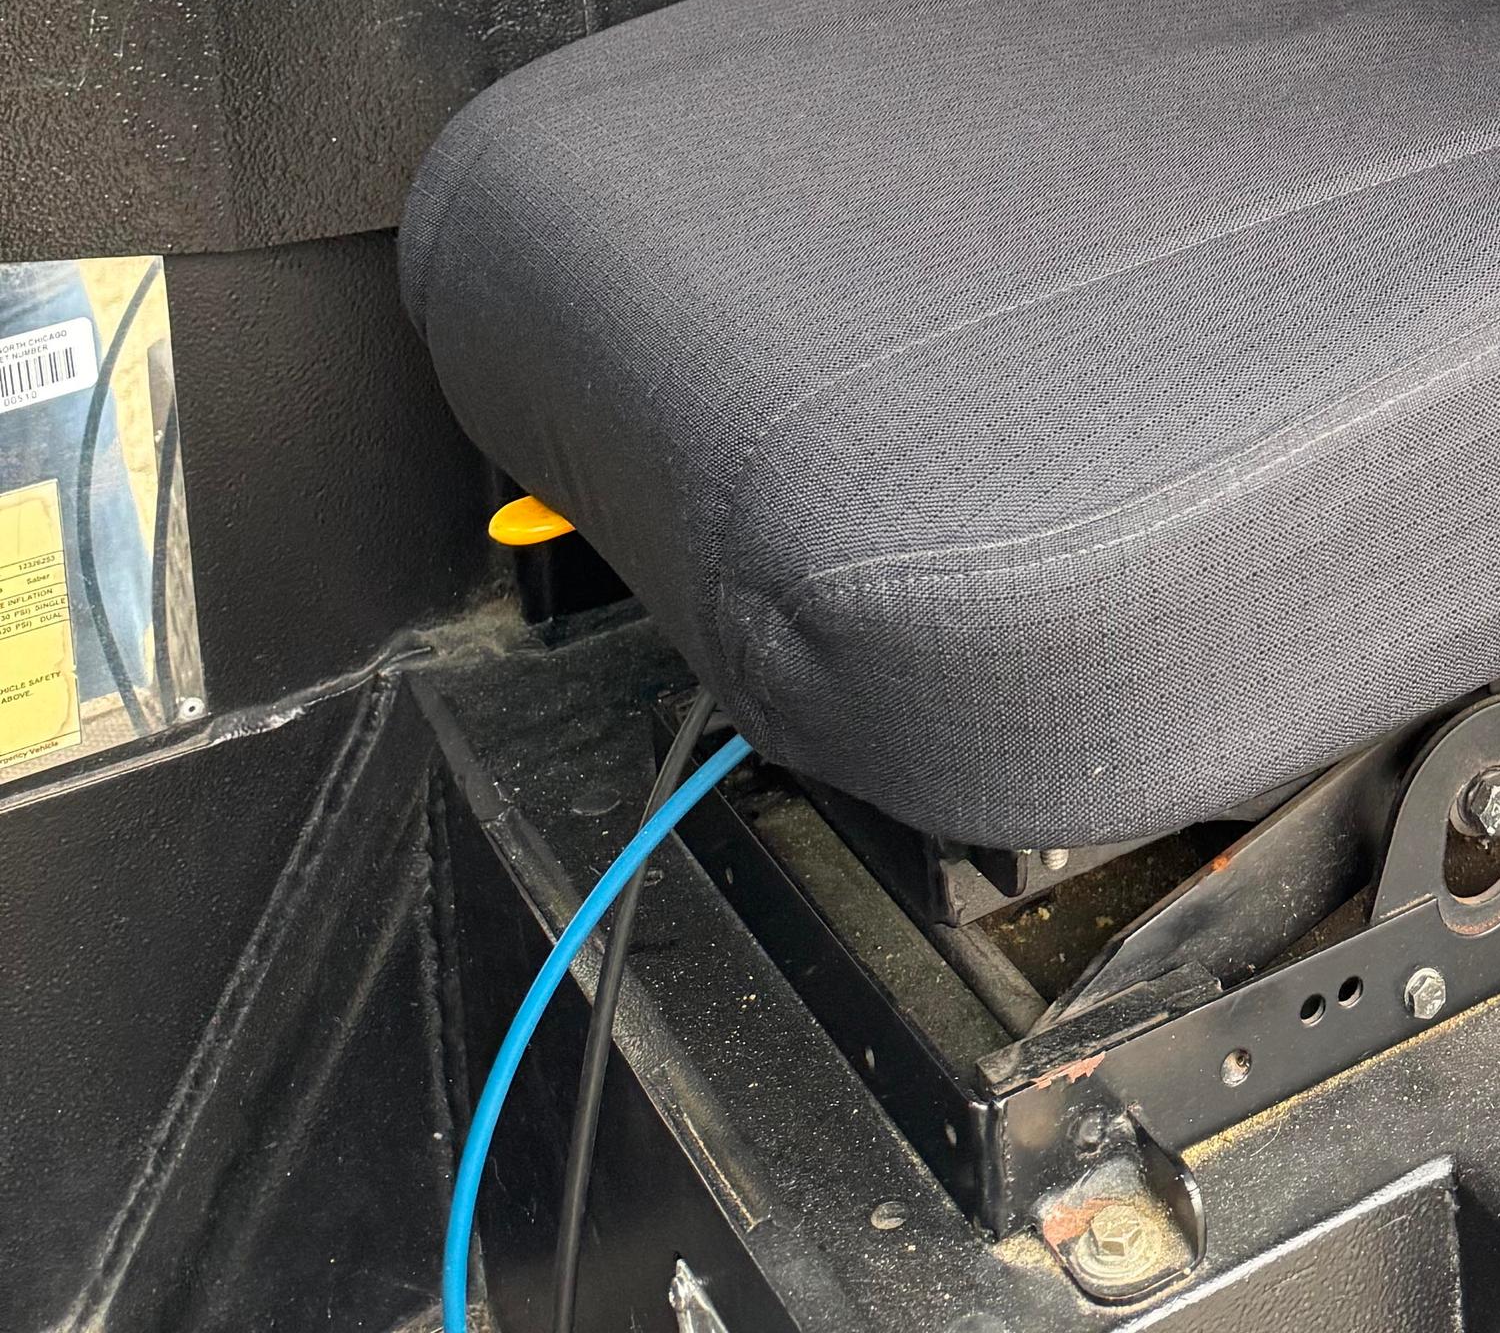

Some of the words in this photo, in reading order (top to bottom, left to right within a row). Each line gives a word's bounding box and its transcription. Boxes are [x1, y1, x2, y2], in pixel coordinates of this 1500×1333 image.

[29, 330, 67, 346] CHICAGO
[12, 345, 48, 360] NUMBER
[8, 588, 53, 606] INFLATION
[35, 598, 66, 611] SINGLE
[40, 612, 62, 623] DUAL
[0, 682, 26, 695] HICLE
[29, 672, 62, 686] SAFETY
[0, 751, 28, 765] rgency
[30, 740, 59, 755] Vehicle
